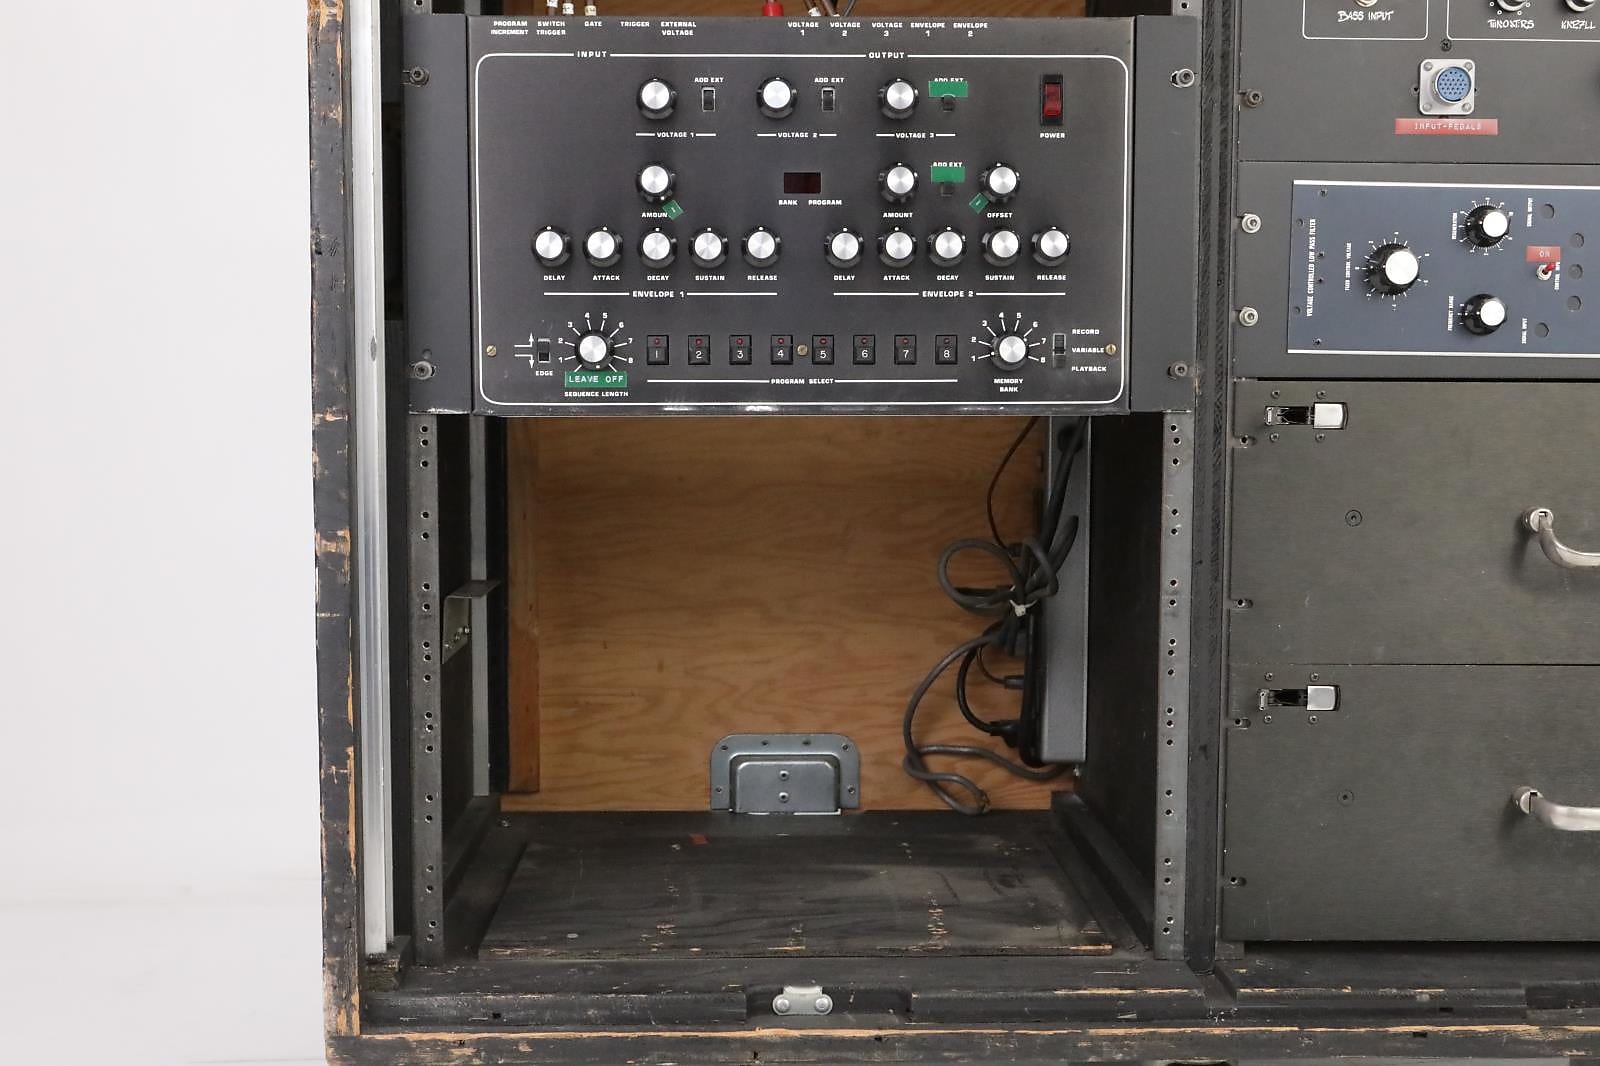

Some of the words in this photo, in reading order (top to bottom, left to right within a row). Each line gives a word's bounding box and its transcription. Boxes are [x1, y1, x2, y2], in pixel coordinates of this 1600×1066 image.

[1338, 11, 1364, 22] BASS
[1368, 11, 1394, 20] INPUT
[801, 29, 804, 37] 1
[842, 29, 847, 37] 2
[926, 29, 929, 37] 1
[968, 30, 973, 38] 2
[577, 50, 607, 58] INPUT
[868, 51, 905, 59] OUTPUT
[1307, 264, 1315, 294] CONTROLLED
[632, 290, 675, 298] ENVELOPE
[680, 290, 684, 298] 1
[922, 290, 965, 298] ENVELOPE
[968, 290, 973, 298] 2
[584, 311, 591, 319] 4
[602, 311, 609, 320] 5
[998, 311, 1004, 319] 4
[566, 320, 574, 329] 3
[617, 320, 625, 329] 6
[557, 336, 564, 345] 2
[627, 336, 634, 344] 7
[654, 350, 659, 359] 1
[695, 350, 702, 359] 2
[736, 350, 743, 359] 3
[777, 350, 784, 358] 4
[820, 350, 826, 359] 5
[861, 349, 868, 358] 6
[903, 350, 909, 358] 7
[943, 350, 950, 358] 8
[557, 355, 564, 364] 1
[627, 356, 635, 364] 8
[1040, 356, 1046, 364] 8
